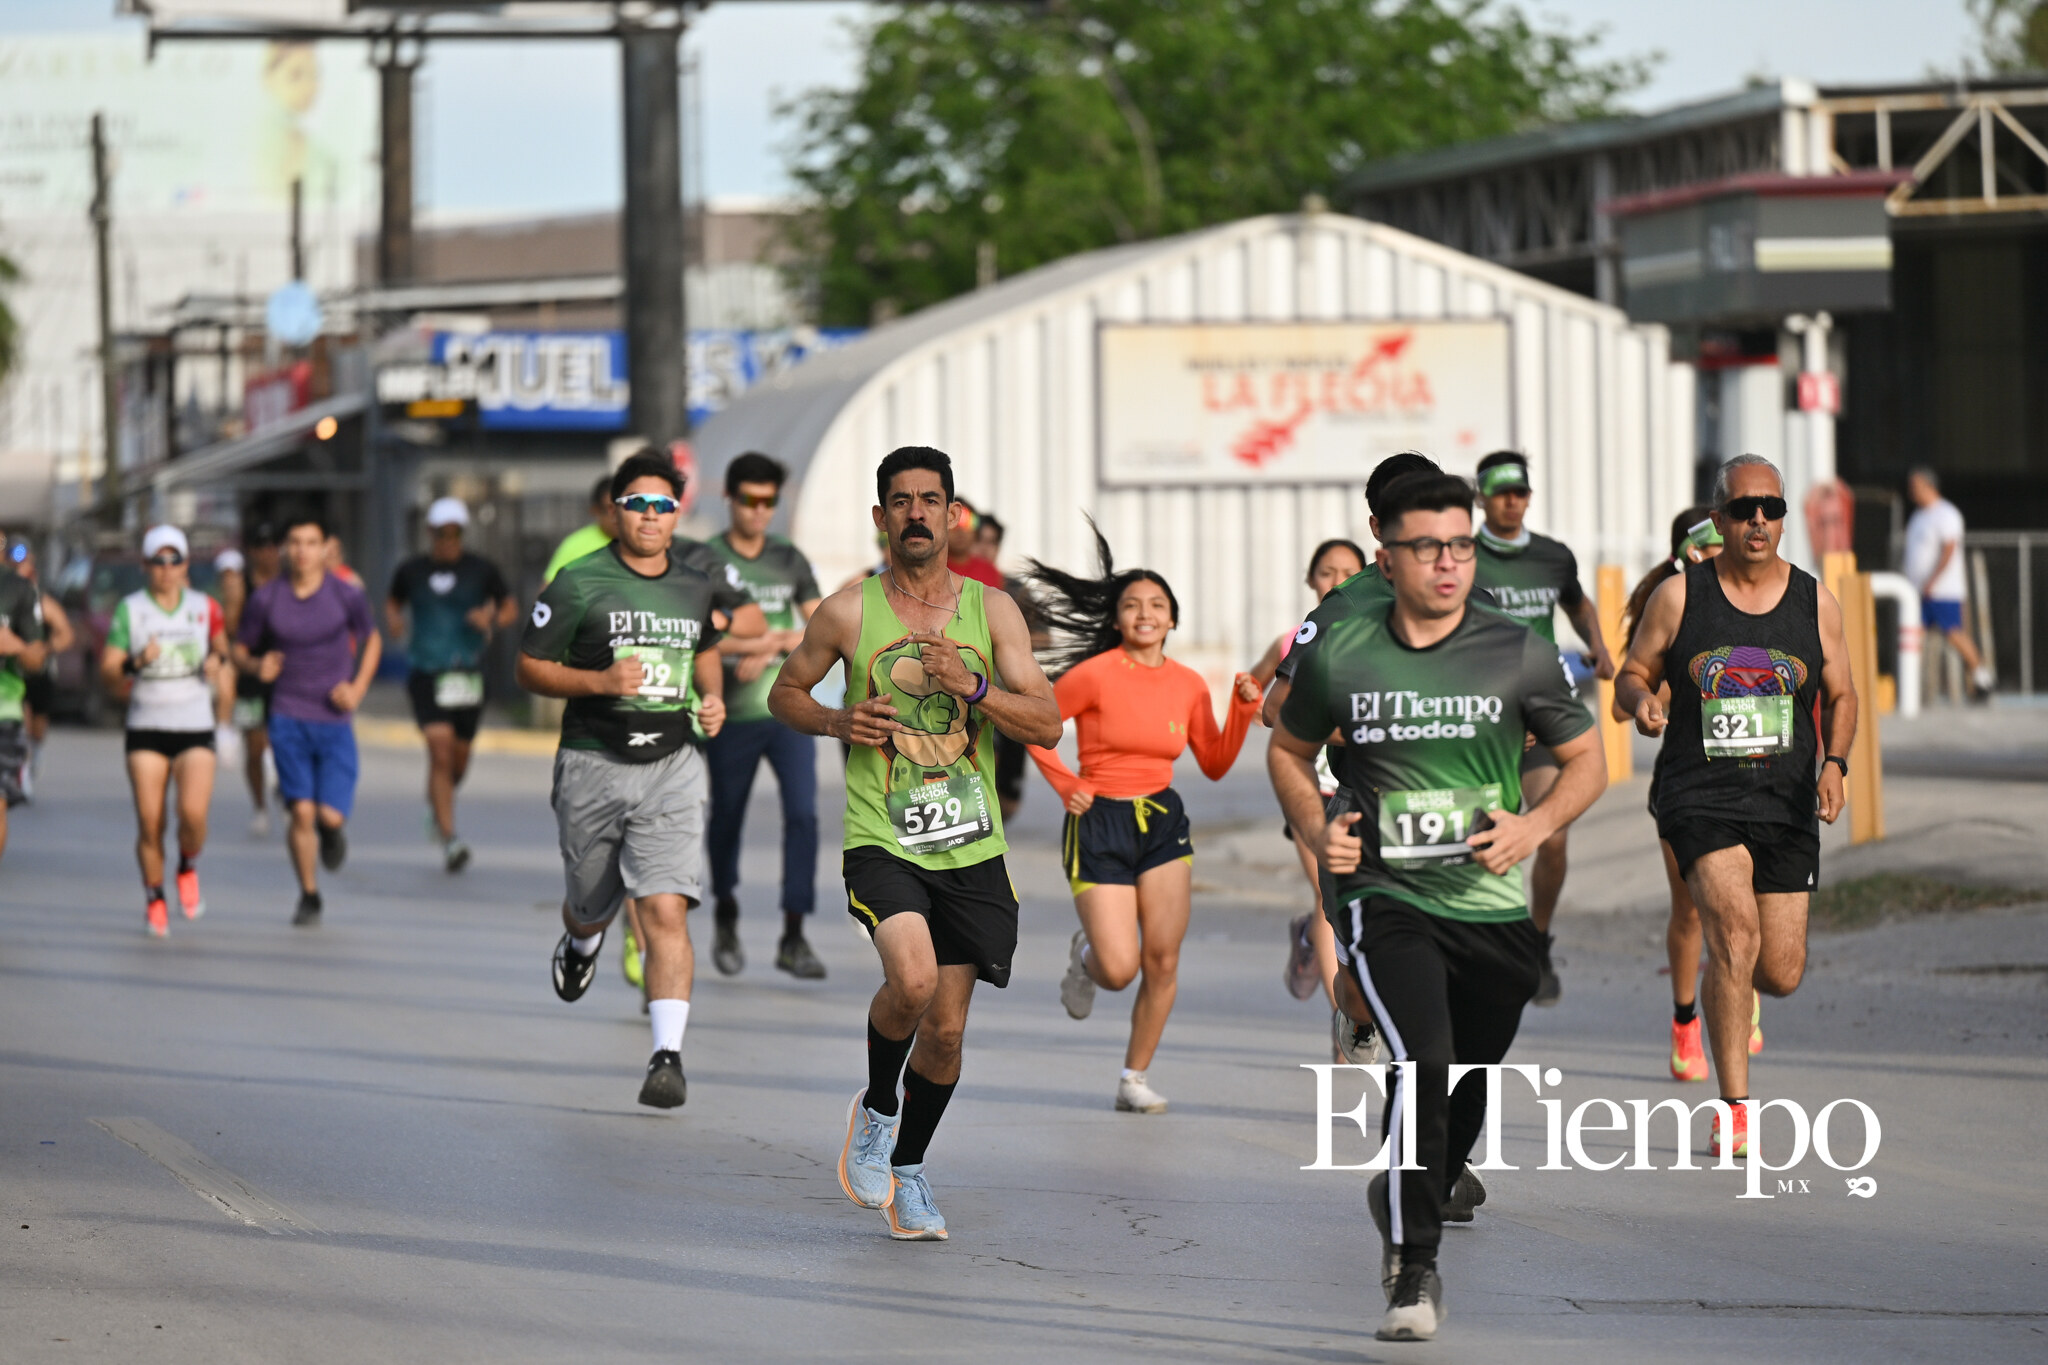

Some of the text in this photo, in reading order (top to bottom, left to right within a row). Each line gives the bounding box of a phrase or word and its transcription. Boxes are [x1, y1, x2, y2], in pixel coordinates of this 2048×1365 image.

[608, 611, 632, 633] El
[1350, 690, 1503, 724] El Tiempo
[1352, 720, 1477, 744] de todos
[1712, 709, 1790, 747] 321 MEDALLA
[909, 776, 981, 795] CARRERA 529
[904, 786, 990, 834] 529 MEDALLA
[1397, 809, 1464, 846] 191
